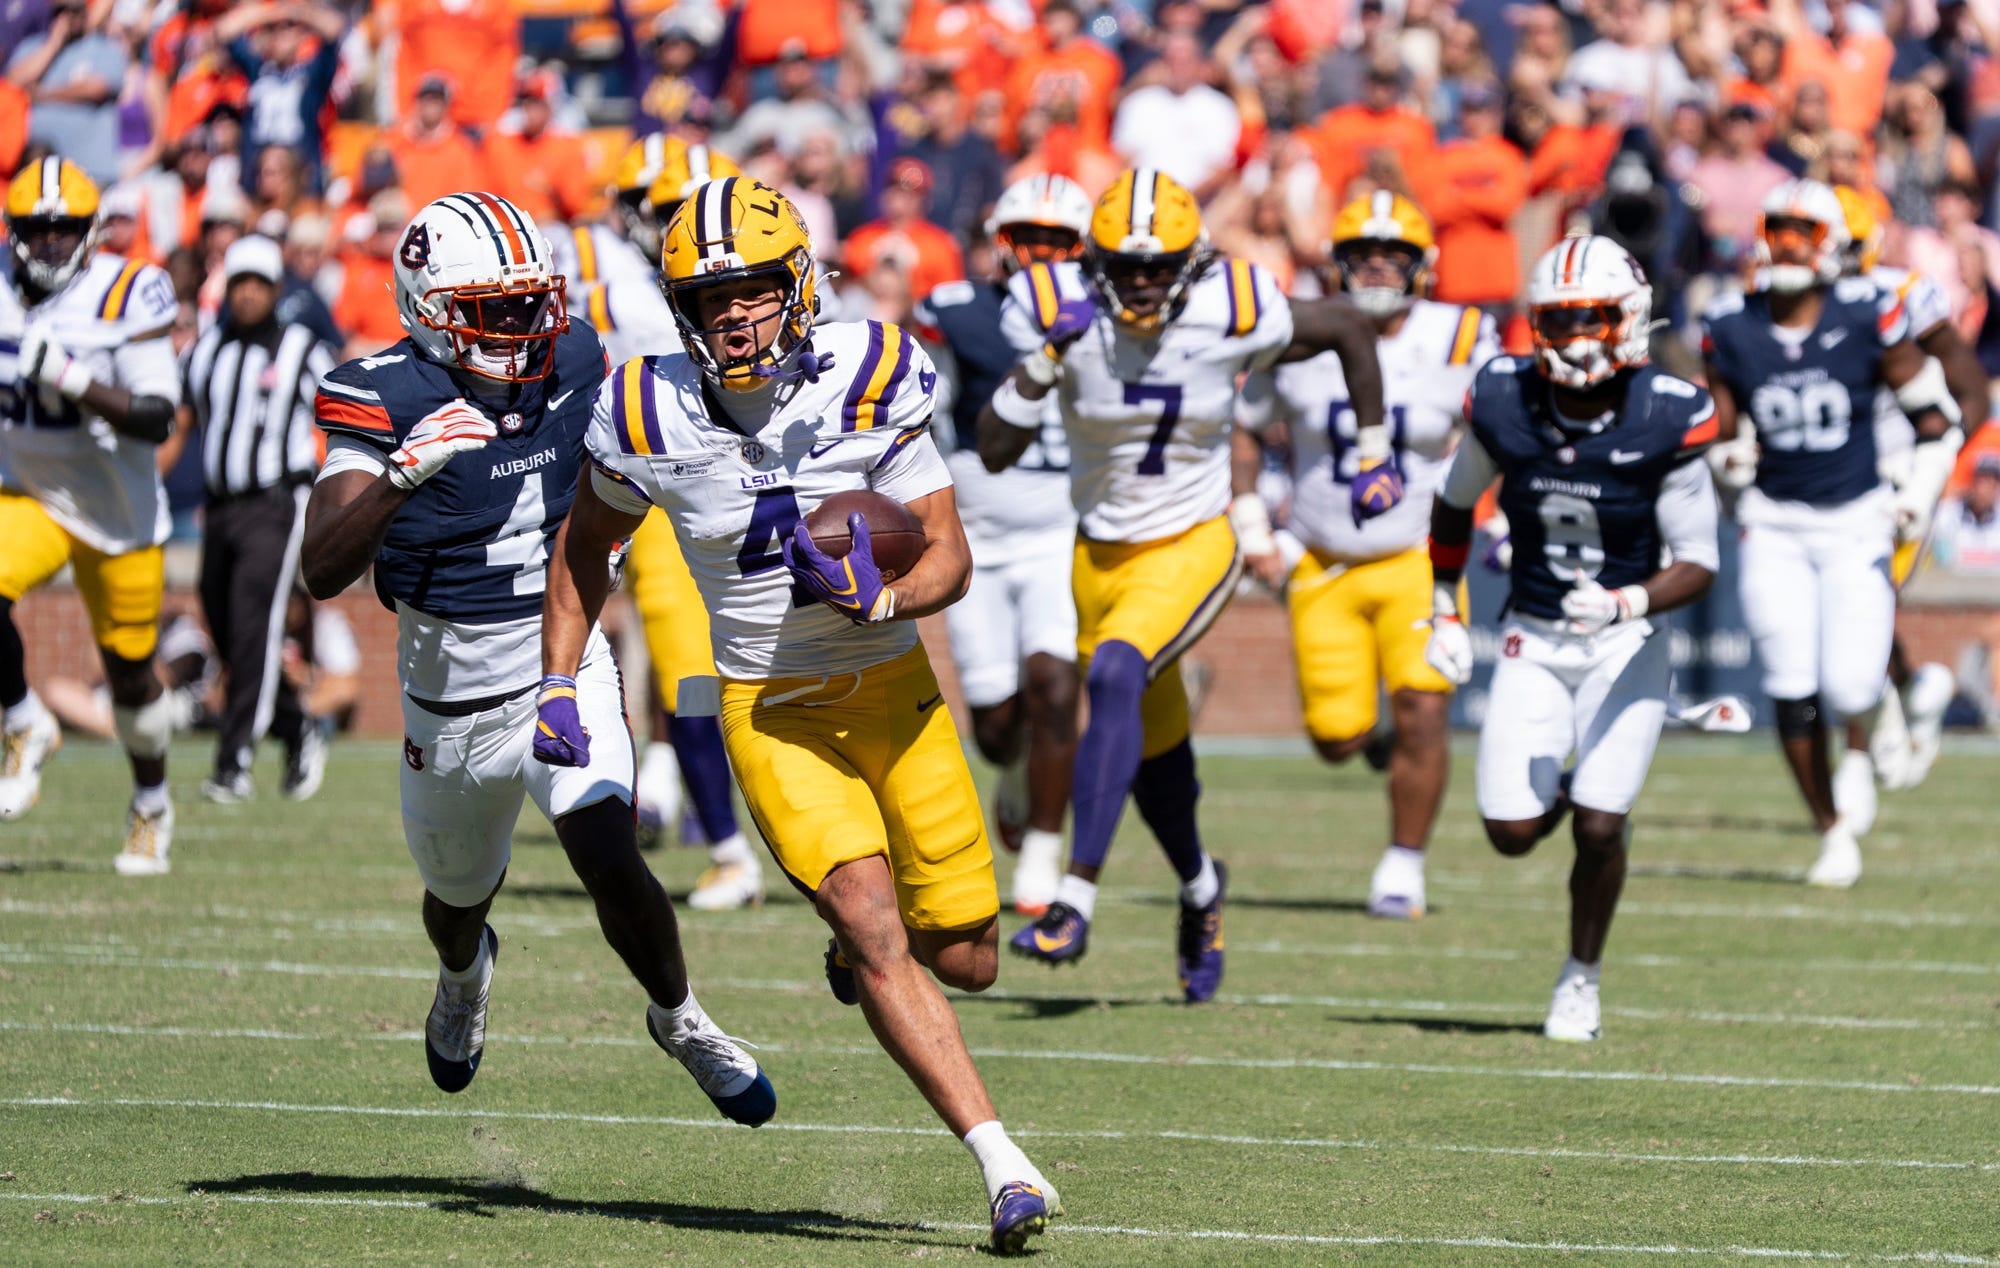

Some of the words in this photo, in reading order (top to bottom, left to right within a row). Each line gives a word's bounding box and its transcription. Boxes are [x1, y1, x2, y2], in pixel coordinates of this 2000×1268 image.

[704, 259, 732, 273] LSU
[503, 412, 522, 430] SEC
[1123, 383, 1183, 475] 7
[1752, 379, 1852, 452] 90
[489, 448, 557, 480] AUBURN
[685, 460, 713, 469] Woodside
[687, 468, 708, 476] Energy
[740, 472, 778, 489] LSU
[1529, 475, 1602, 499] AUBURN
[486, 472, 549, 596] 4
[736, 485, 828, 609] 4
[1538, 493, 1606, 582] 8
